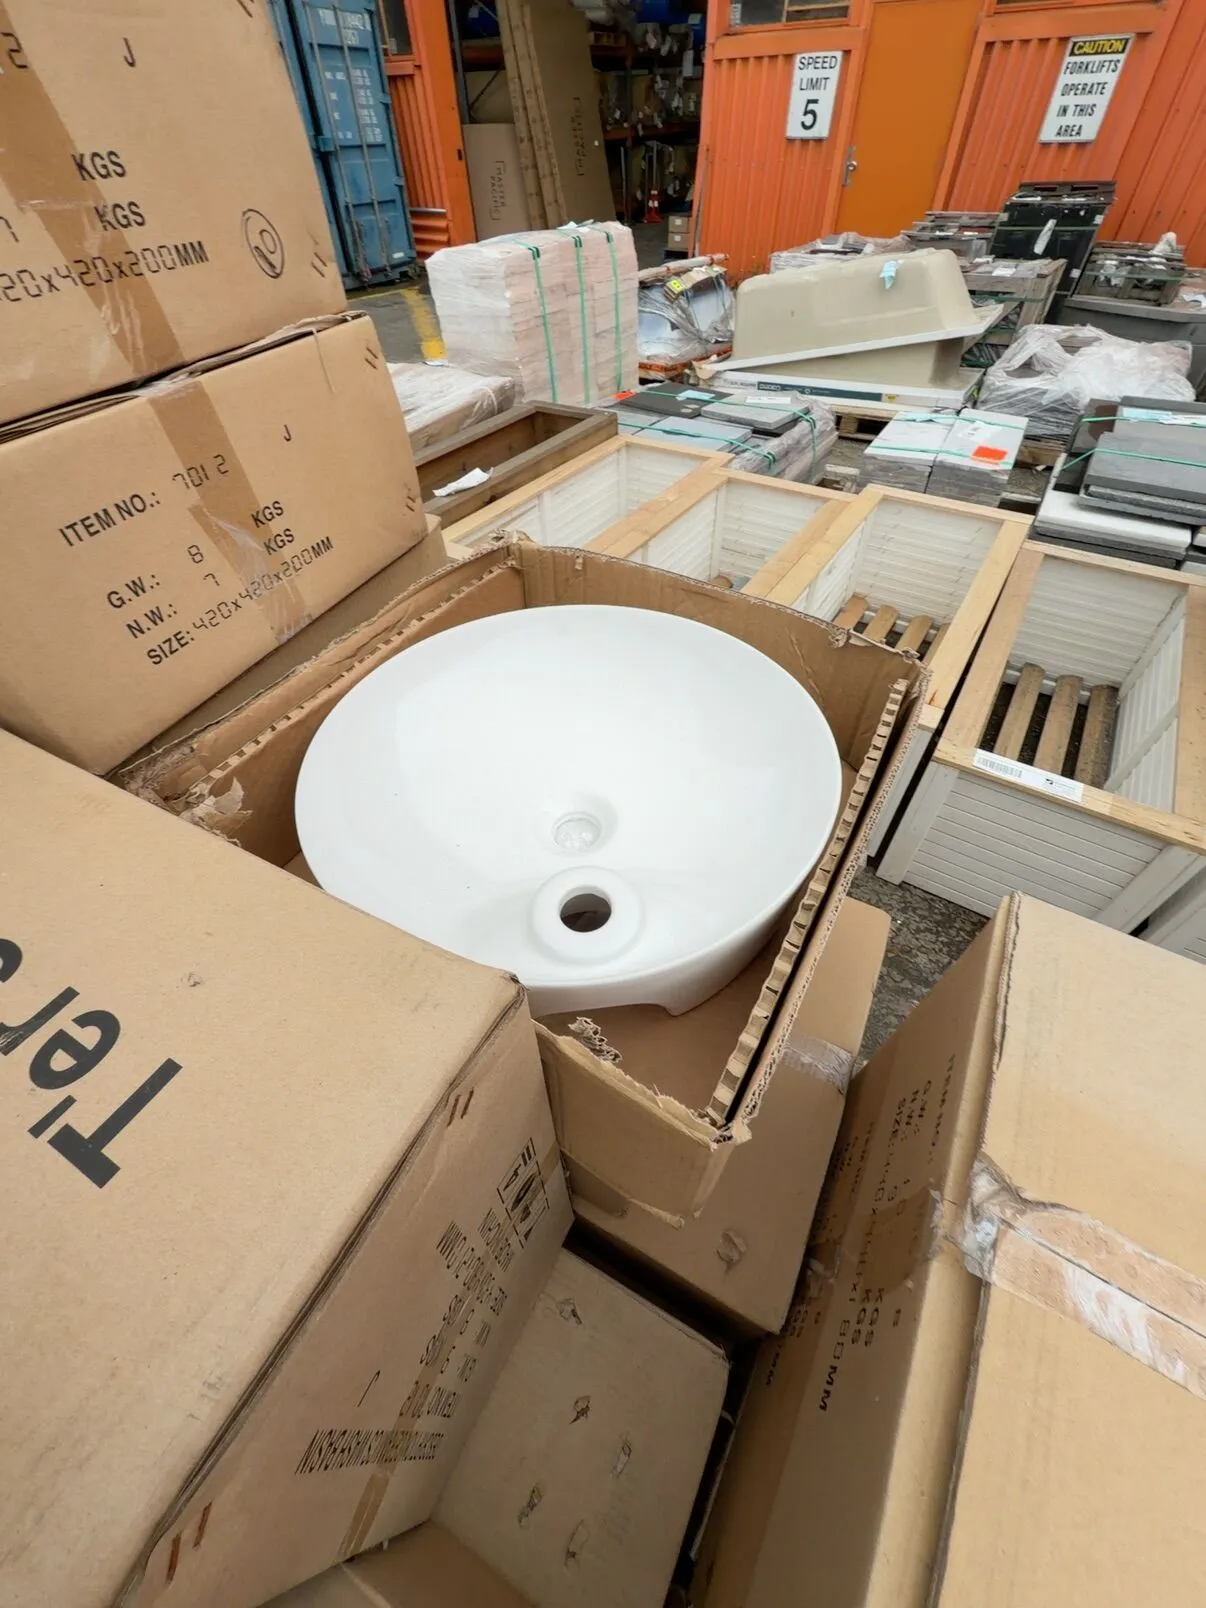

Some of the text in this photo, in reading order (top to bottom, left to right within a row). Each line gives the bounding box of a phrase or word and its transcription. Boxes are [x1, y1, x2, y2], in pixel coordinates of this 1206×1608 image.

[122, 37, 137, 67] J
[1073, 40, 1125, 54] CAUTION
[798, 55, 838, 70] SPEED
[1063, 59, 1120, 75] FORKLIFTS
[799, 77, 830, 91] LIMIT
[1061, 82, 1108, 96] OPERATE
[801, 98, 820, 131] 5
[1056, 103, 1097, 118] IN THIS
[1055, 124, 1083, 137] AREA
[72, 150, 126, 181] KGS
[95, 201, 146, 231] KGS
[0, 240, 210, 303] 20x420x200MM
[58, 507, 118, 547] ITEM
[116, 491, 161, 523] NO.:
[283, 424, 293, 442] J
[105, 501, 285, 610] G.W.: 8 KGS
[126, 528, 296, 640] N.W.: 7 KGS
[146, 628, 196, 666] SIZE:
[850, 1287, 872, 1345] KGS
[864, 1287, 885, 1347] KGS
